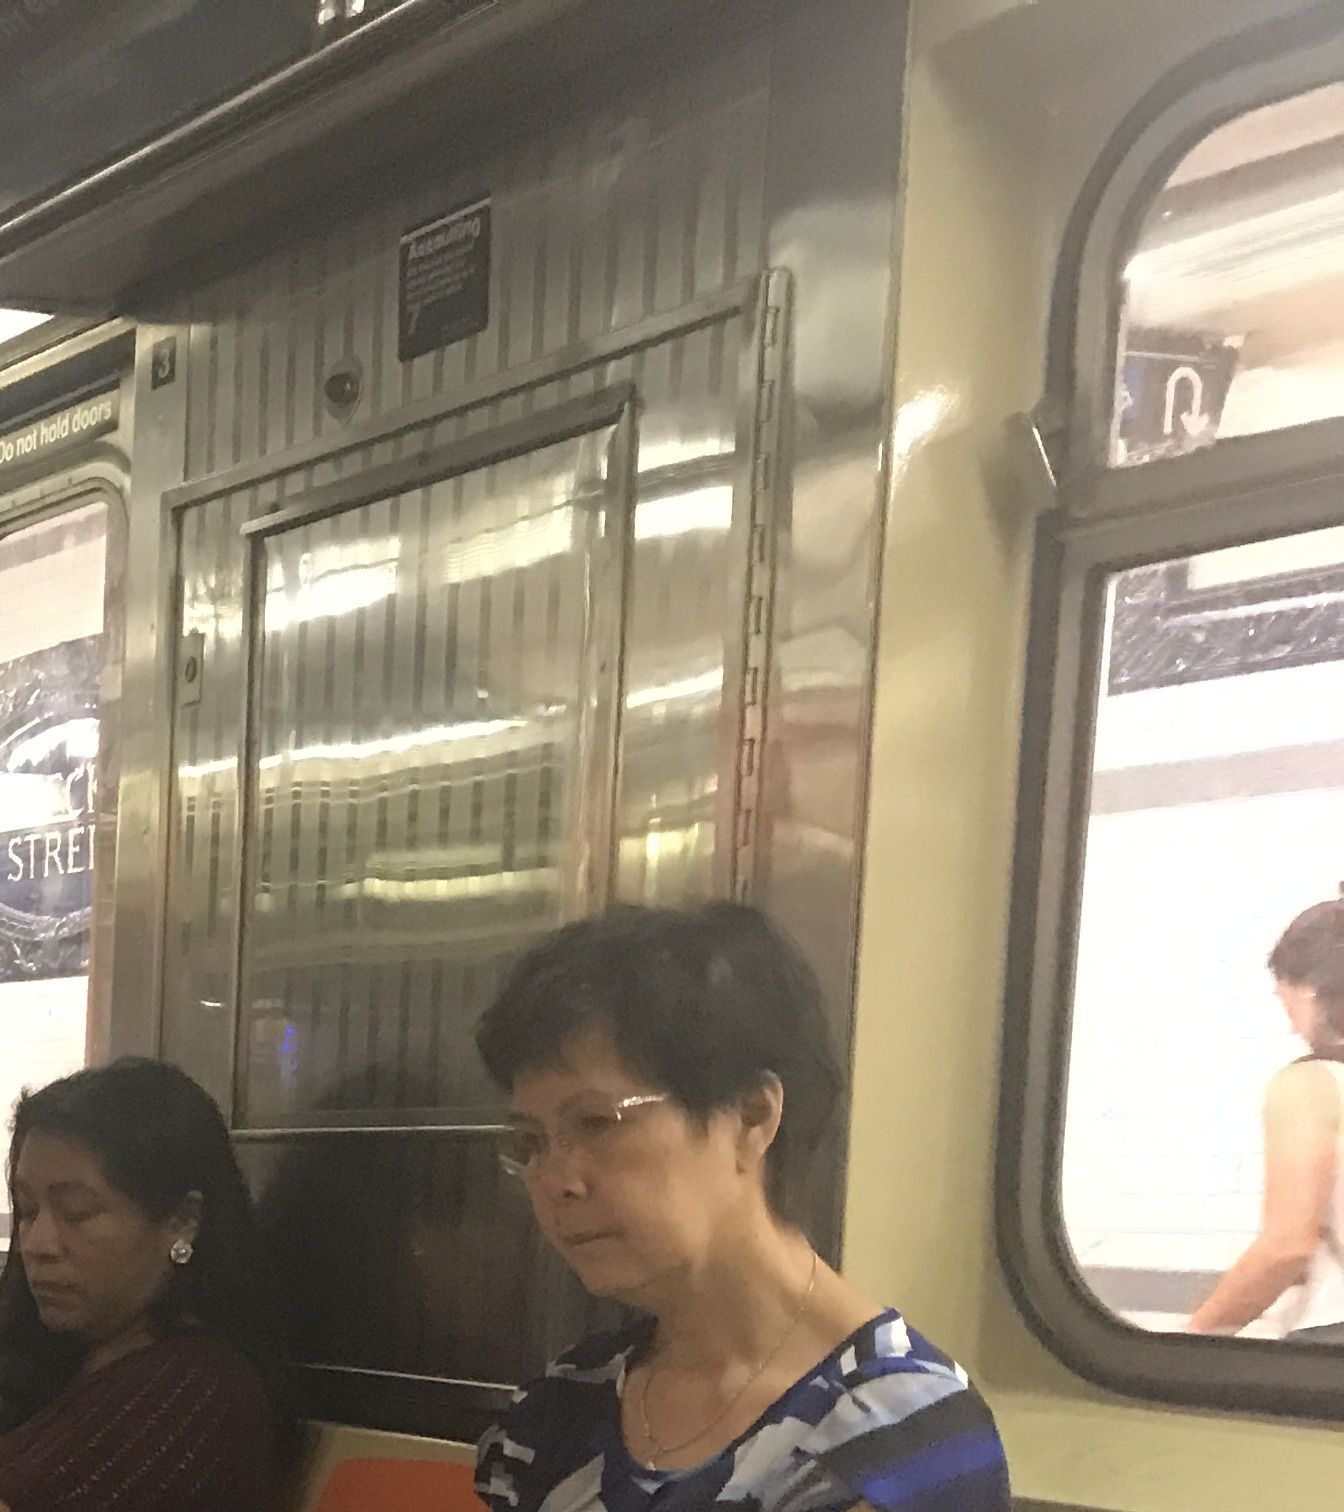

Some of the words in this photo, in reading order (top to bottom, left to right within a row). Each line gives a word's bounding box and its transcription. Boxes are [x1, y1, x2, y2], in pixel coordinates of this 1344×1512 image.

[158, 349, 171, 378] 3
[16, 429, 38, 457] not
[39, 413, 69, 446] hold
[72, 400, 112, 433] doors
